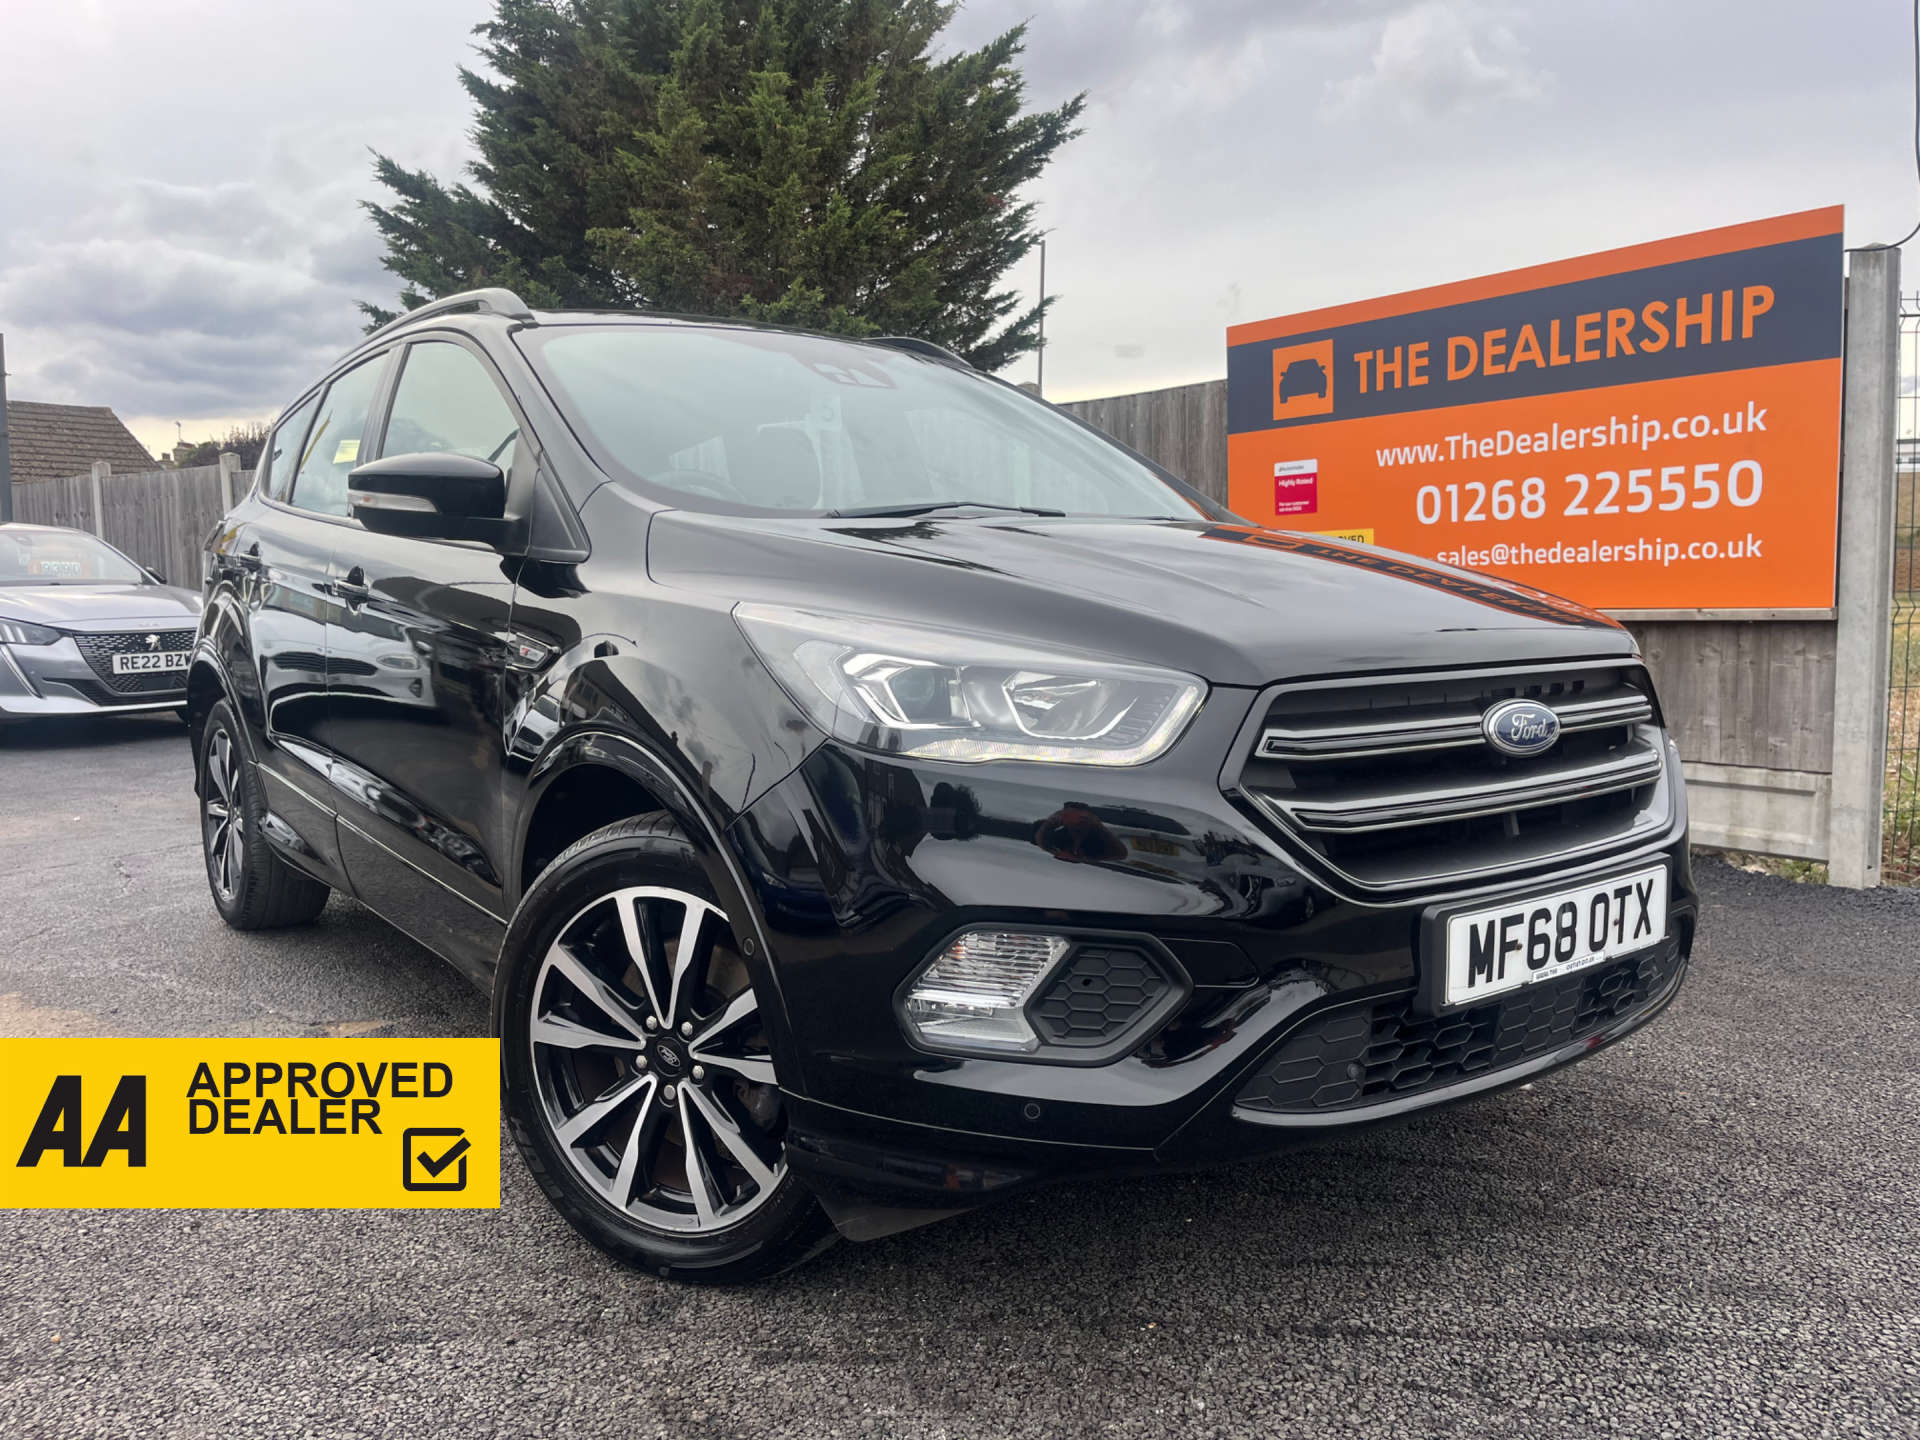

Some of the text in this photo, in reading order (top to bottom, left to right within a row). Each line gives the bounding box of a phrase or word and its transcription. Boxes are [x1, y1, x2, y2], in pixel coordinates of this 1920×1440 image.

[1354, 284, 1775, 394] THE DEALERSHIP
[1376, 401, 1767, 467] www.TheDealership.co.uk
[1416, 459, 1763, 525] 01268 225550
[1436, 532, 1763, 567] sales@thedealership.co.uk
[120, 655, 161, 671] RE22
[1510, 713, 1551, 741] Ford
[1467, 878, 1654, 989] MF68 OTX
